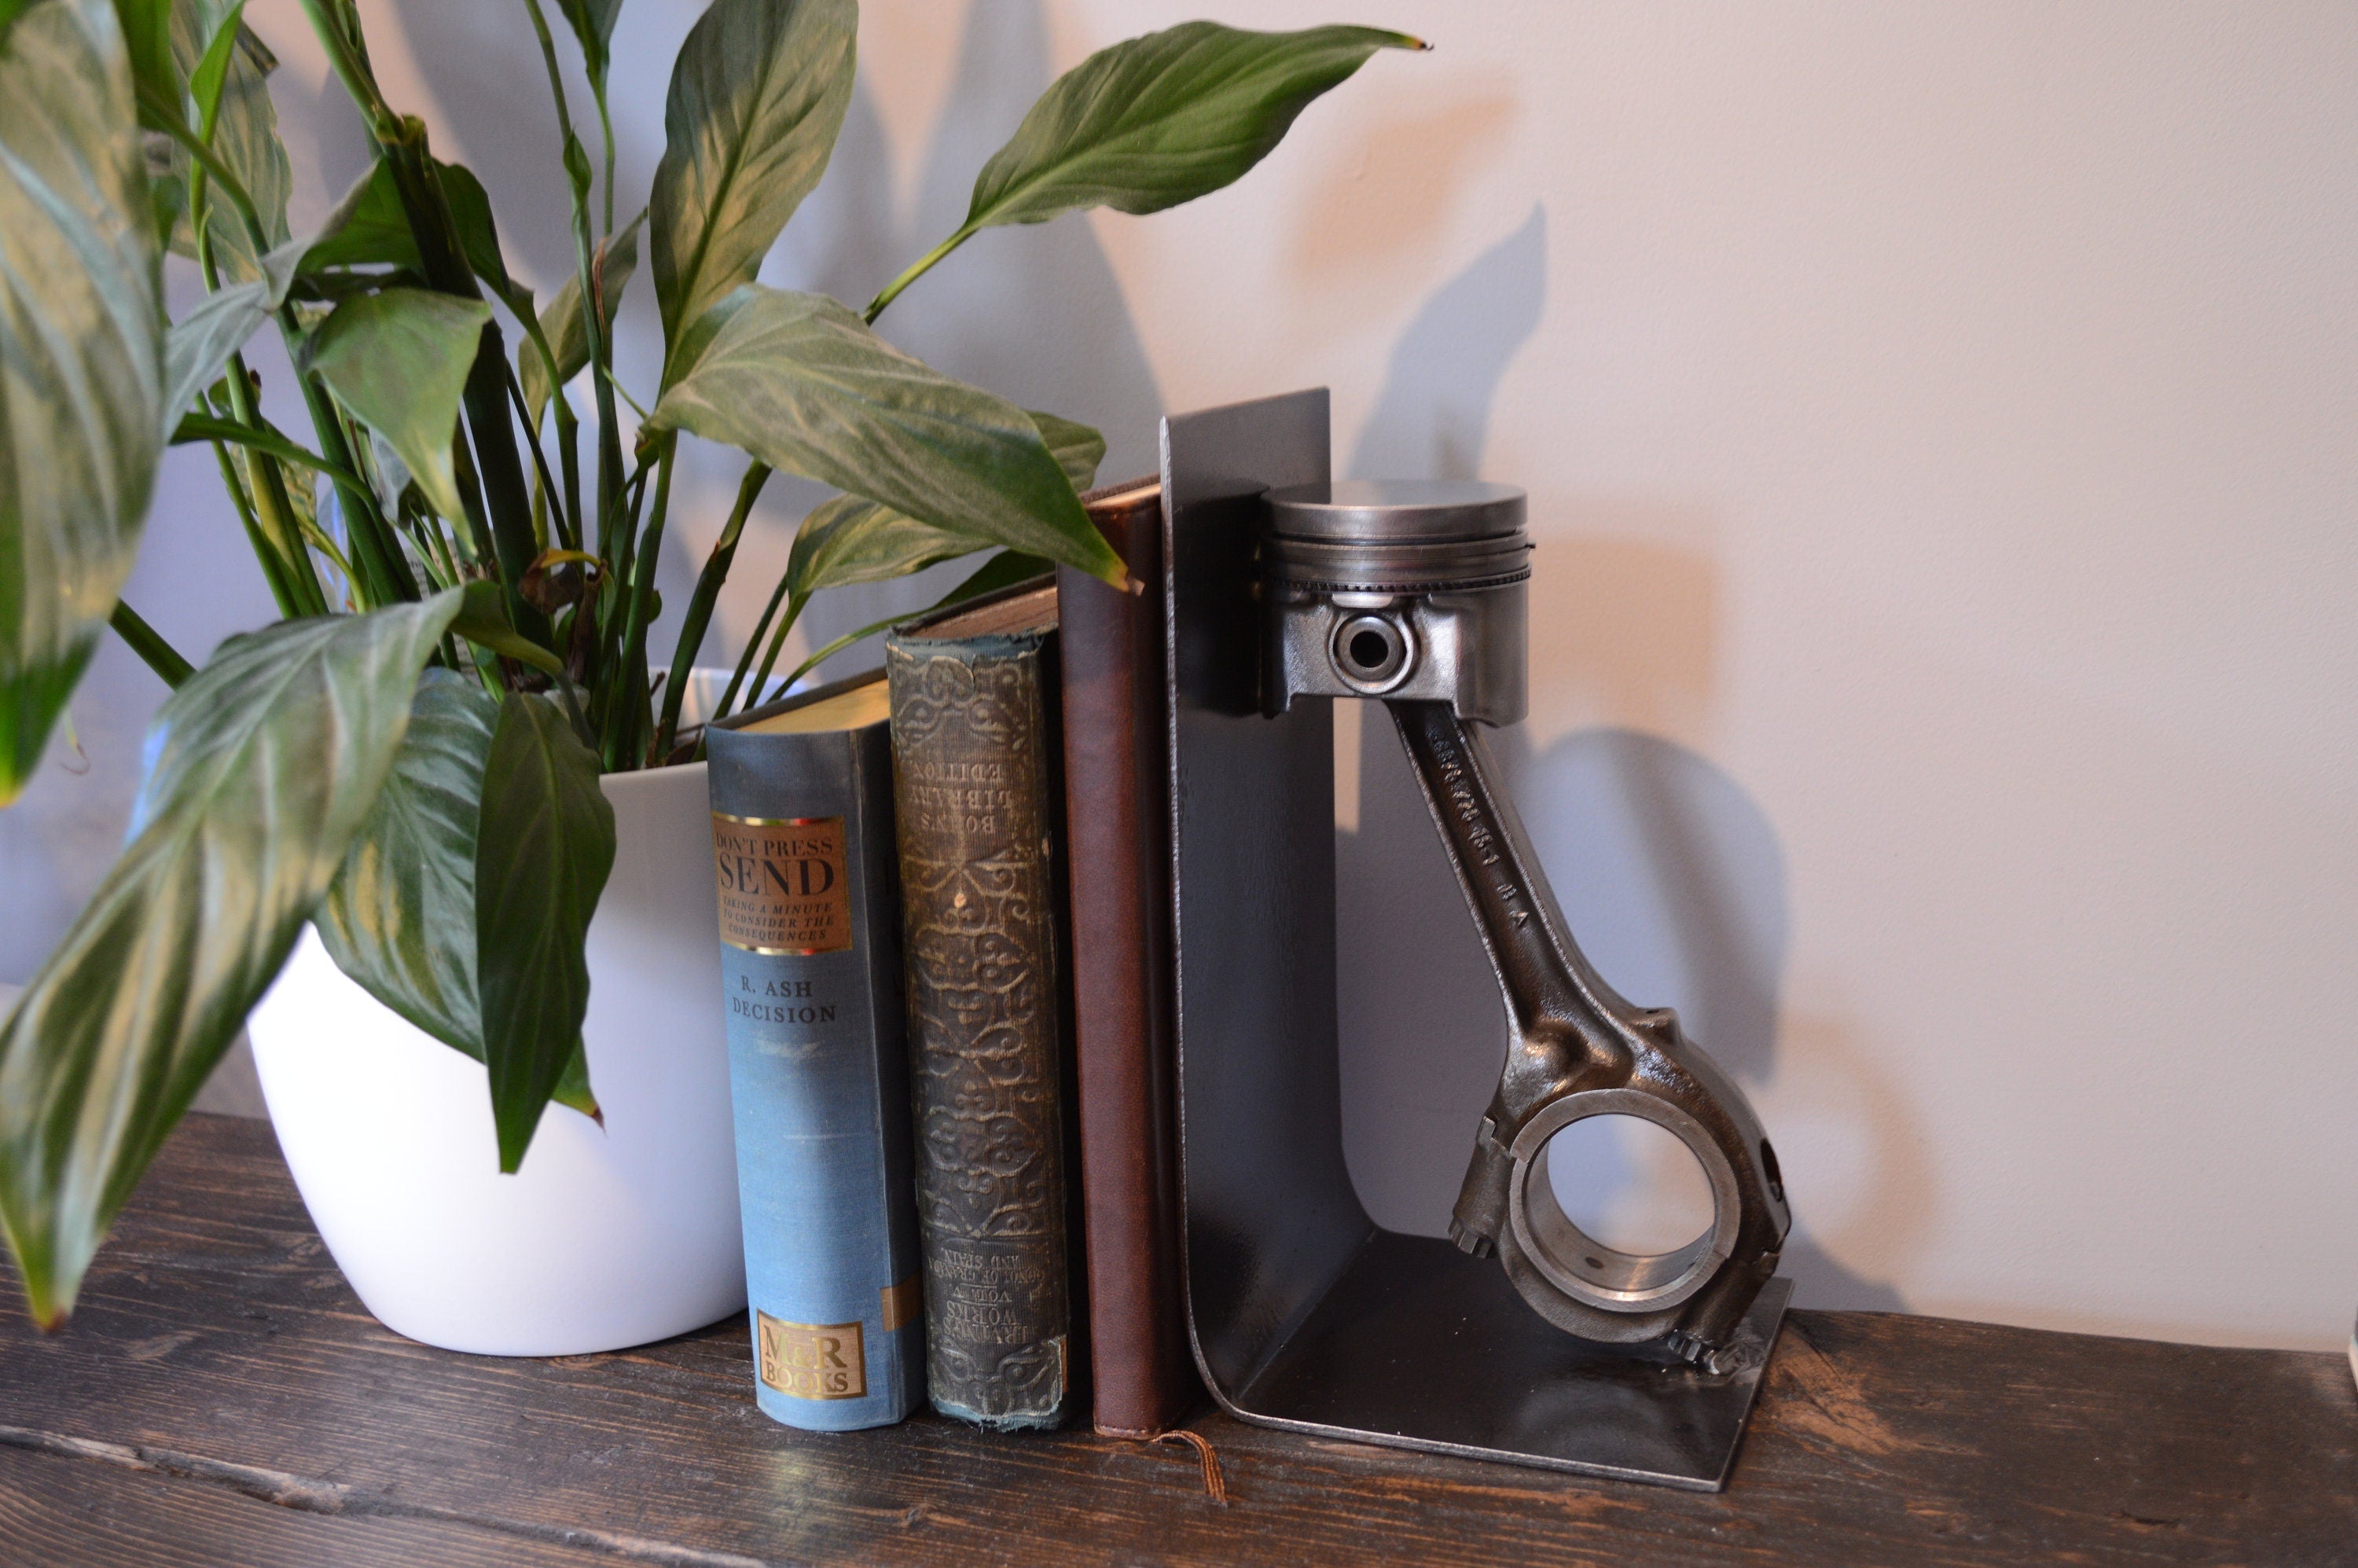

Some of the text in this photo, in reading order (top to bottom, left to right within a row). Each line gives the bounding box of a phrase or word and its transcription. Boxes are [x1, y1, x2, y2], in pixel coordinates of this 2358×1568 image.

[716, 832, 832, 857] DON'T PRESS
[719, 850, 834, 896] SEND
[722, 895, 832, 915] TAKING A MINUTE
[723, 909, 834, 928] TO CONSIDER THE
[729, 923, 826, 942] CONSEQUENCES
[741, 975, 813, 997] R. ASH
[732, 996, 836, 1023] DECISION
[766, 1362, 849, 1394] BOOKS
